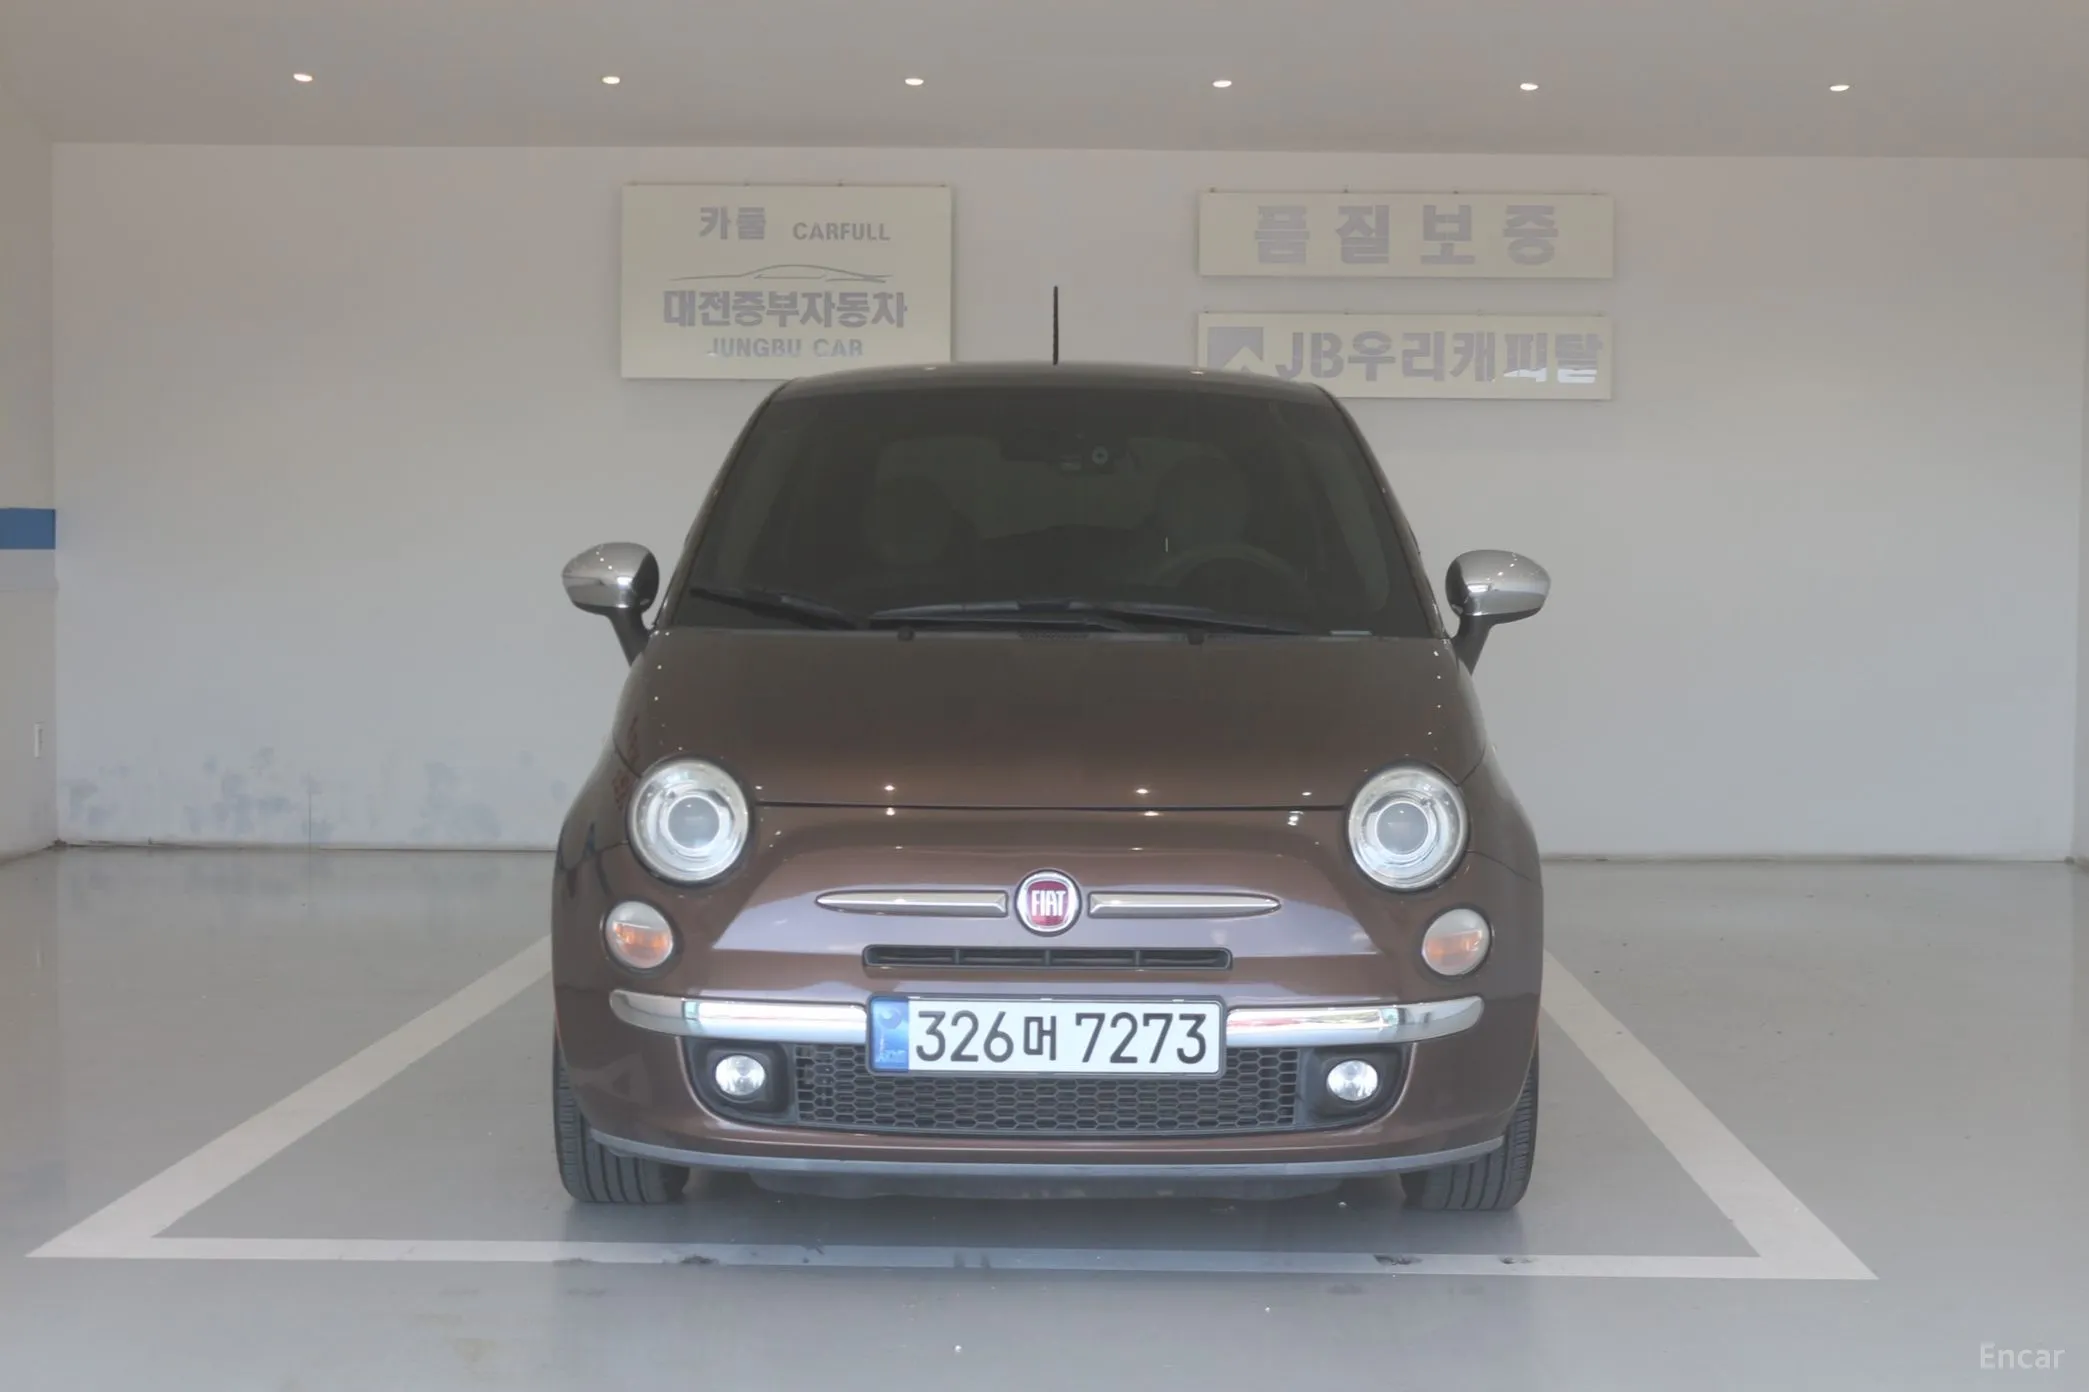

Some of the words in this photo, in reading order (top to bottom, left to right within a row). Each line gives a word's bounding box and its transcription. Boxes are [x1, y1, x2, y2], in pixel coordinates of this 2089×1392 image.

[792, 222, 891, 241] CARFULL
[663, 290, 908, 328] 대전중부자동차
[710, 337, 801, 357] JUNGBU
[813, 337, 864, 358] CAR
[1275, 330, 1603, 383] JB우리캐피탈
[1031, 889, 1067, 917] FIAT
[916, 1010, 1058, 1062] 326머
[1075, 1012, 1207, 1064] 7273
